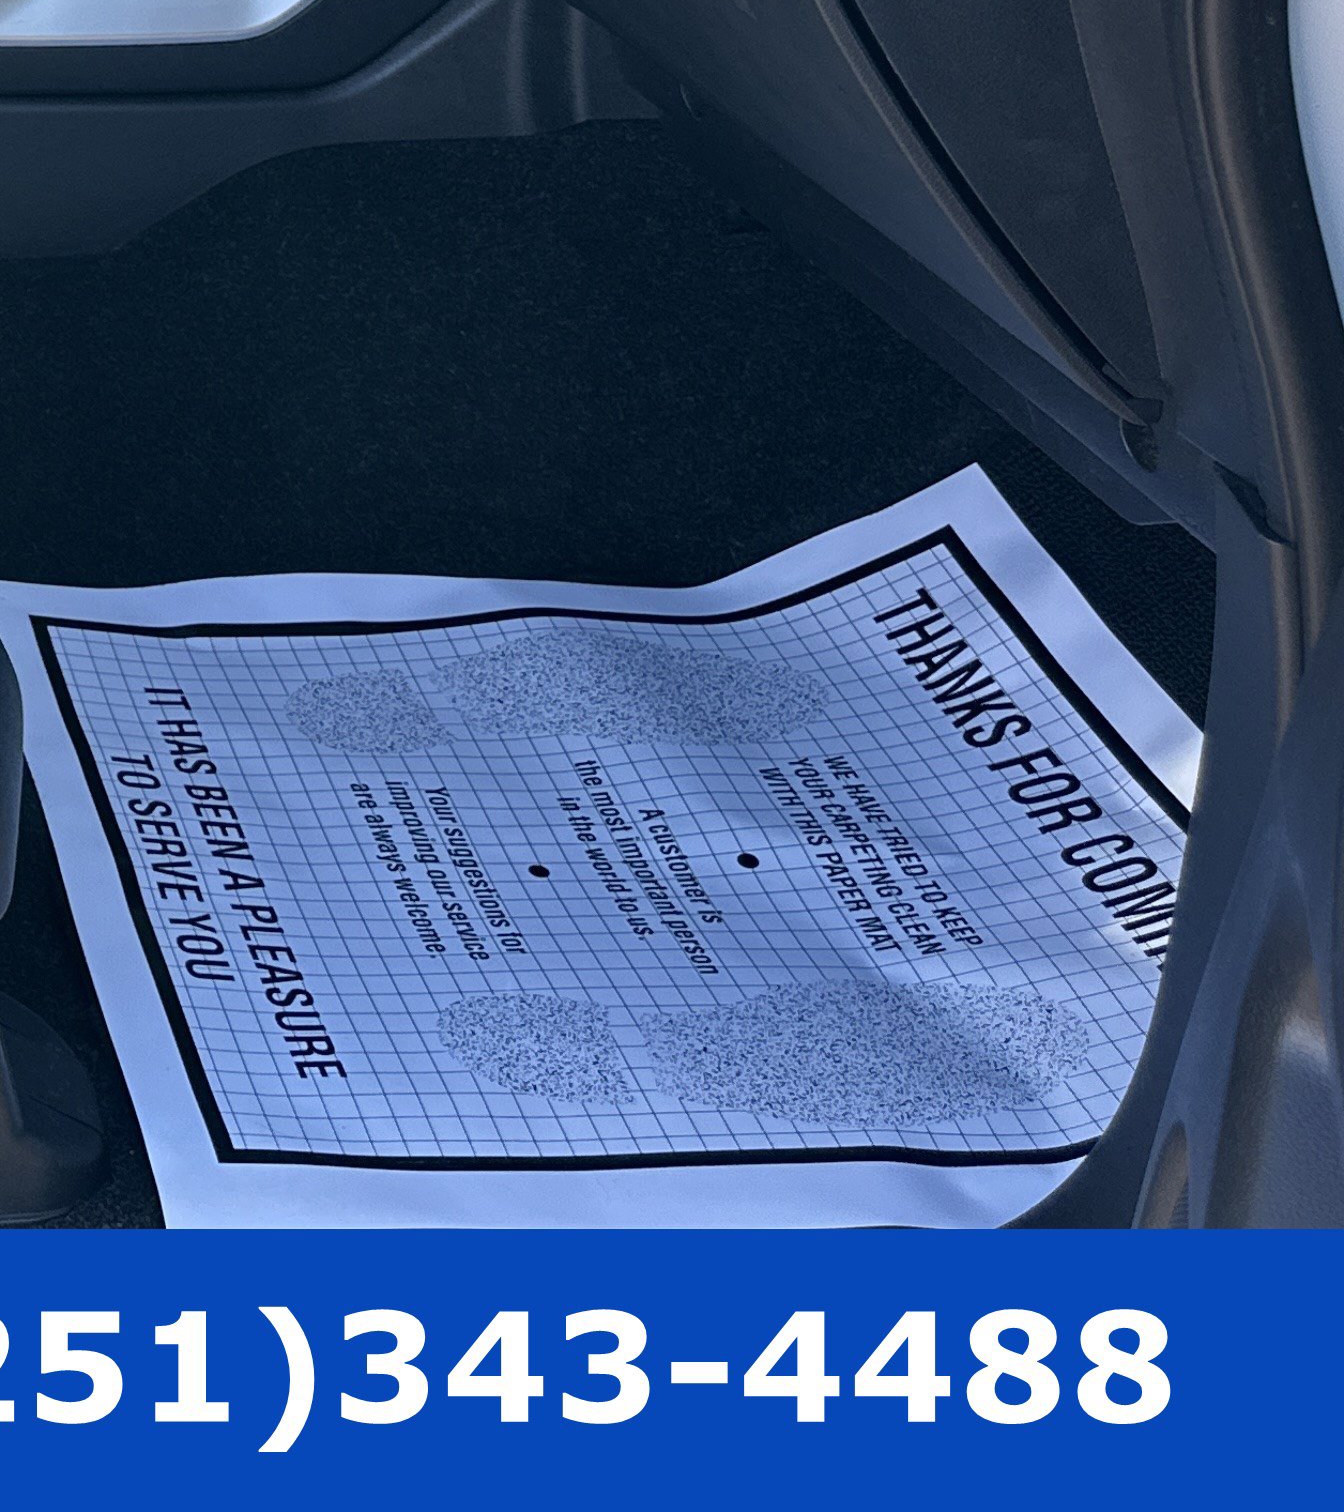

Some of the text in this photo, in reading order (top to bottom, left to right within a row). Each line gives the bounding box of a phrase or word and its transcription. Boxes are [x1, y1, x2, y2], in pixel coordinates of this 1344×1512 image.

[111, 754, 235, 983] TO SERVE YOU
[350, 782, 446, 959] are always welcome.
[385, 780, 490, 961] improving our service
[425, 785, 527, 955] Your suggestions for
[557, 794, 654, 941] in the world to us.
[575, 759, 719, 975] the most important person
[639, 808, 723, 924] A customer is
[759, 767, 902, 952] WITH THIS PAPER MAT
[789, 757, 946, 955] YOUR CARPETING CLEAN
[824, 756, 983, 946] WE HAVE TRIED TO KEEP
[873, 588, 1176, 971] THANKS FOR COMI
[144, 687, 347, 1079] IT HAS BEEN A PLEASURE
